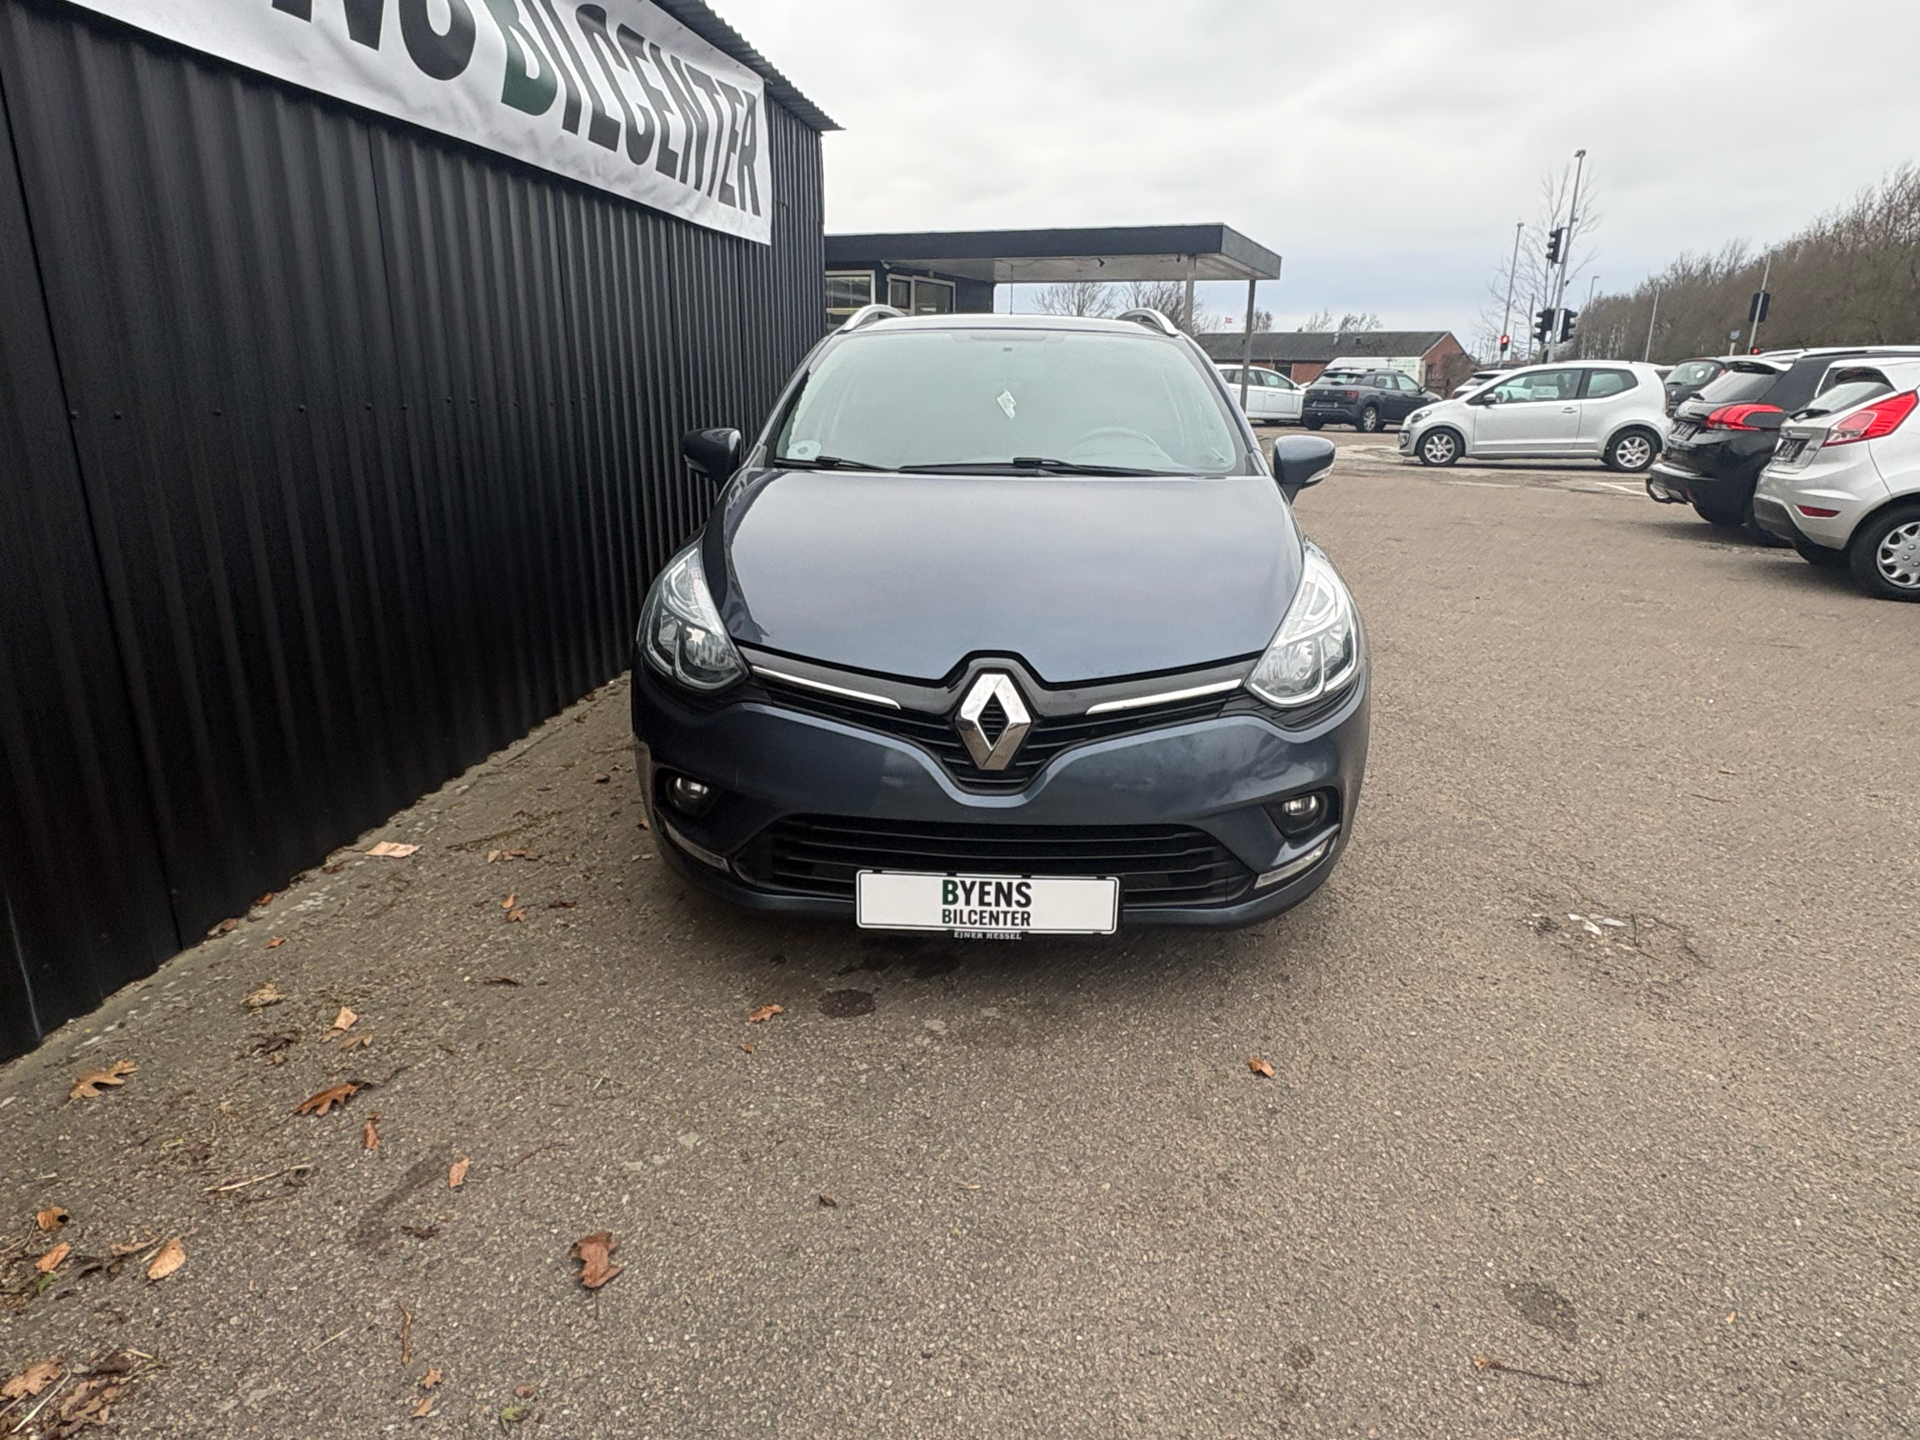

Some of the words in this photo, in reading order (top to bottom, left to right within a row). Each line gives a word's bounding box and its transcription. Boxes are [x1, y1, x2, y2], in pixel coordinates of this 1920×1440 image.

[482, 0, 762, 218] BILCENTER
[942, 879, 1032, 908] BYENS
[942, 909, 1031, 926] BILCENTER
[953, 931, 983, 939] EJNER
[986, 932, 1022, 940] HESSEL
